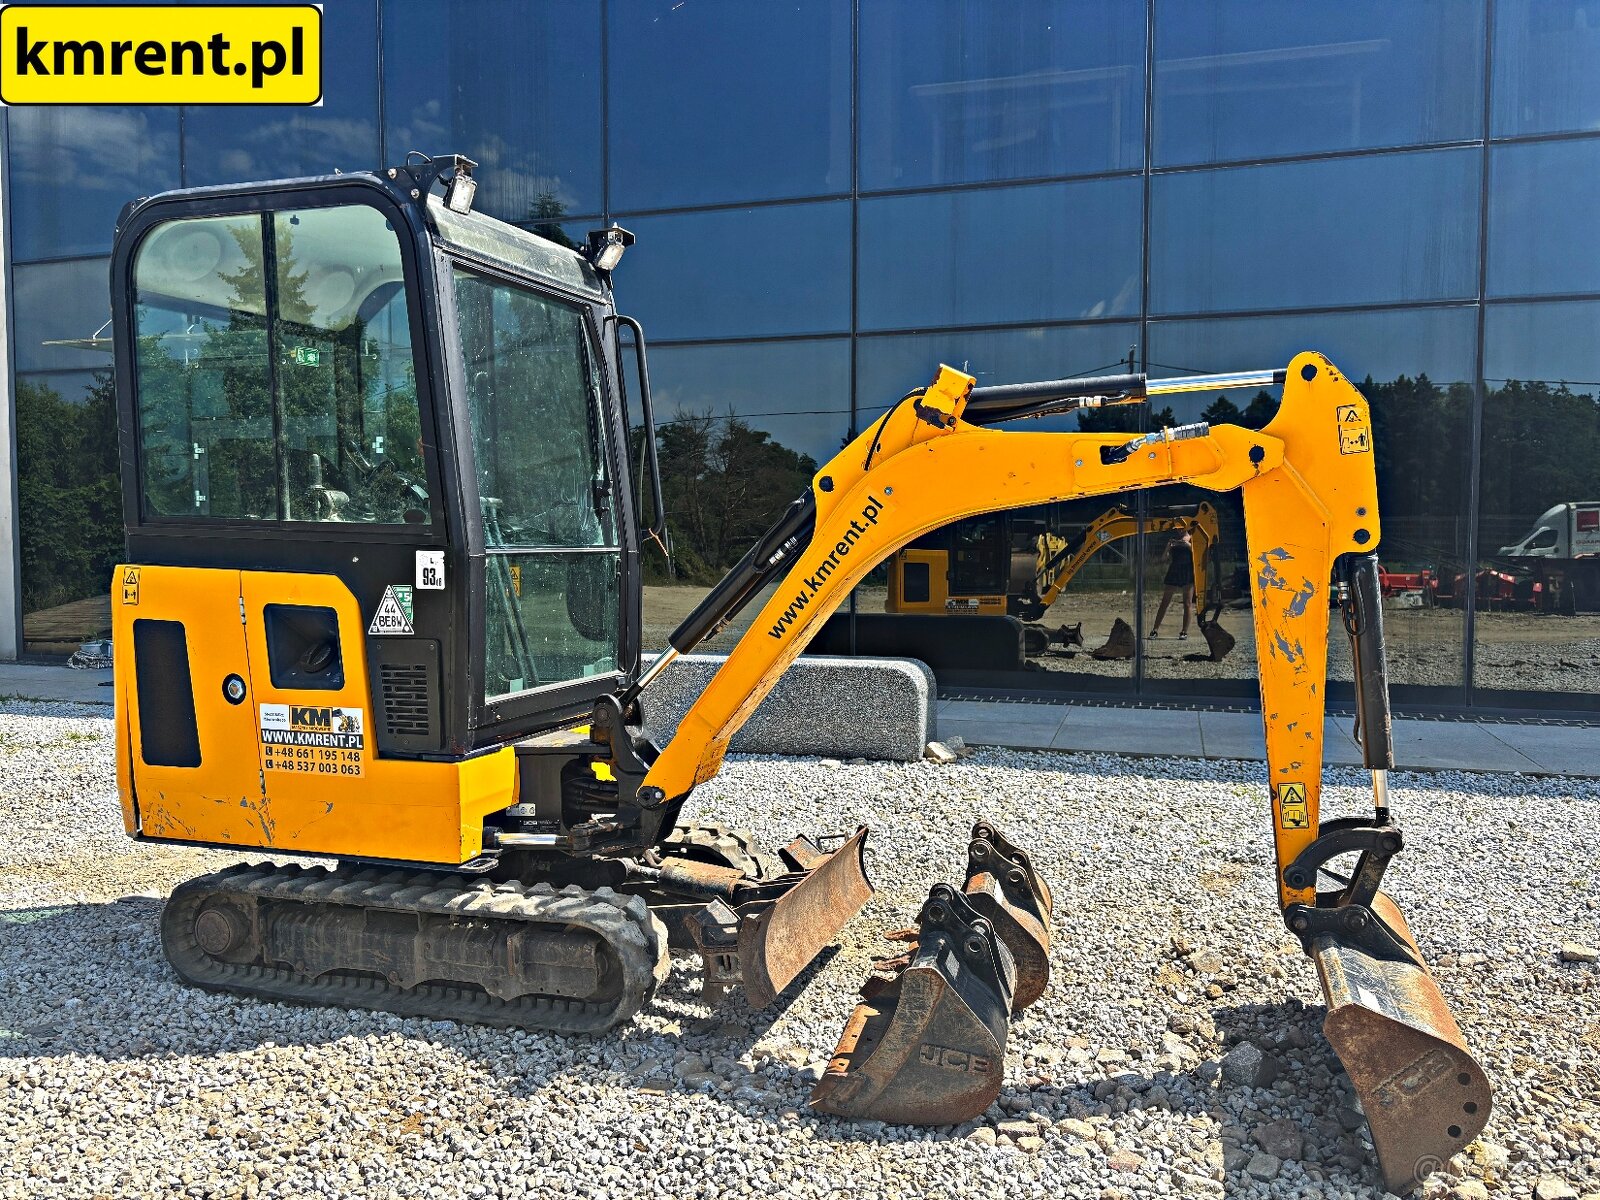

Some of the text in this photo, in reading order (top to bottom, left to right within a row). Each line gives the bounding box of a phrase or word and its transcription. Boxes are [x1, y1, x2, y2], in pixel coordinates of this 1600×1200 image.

[768, 495, 884, 639] www.kmrent.pl
[423, 567, 436, 586] 93
[384, 604, 397, 615] 44
[291, 707, 331, 727] KM
[261, 730, 363, 748] WWW.KMRENT.PL
[275, 747, 361, 763] +48 661 195 148
[275, 760, 361, 775] +48 537 003 063
[918, 1042, 993, 1075] JCB
